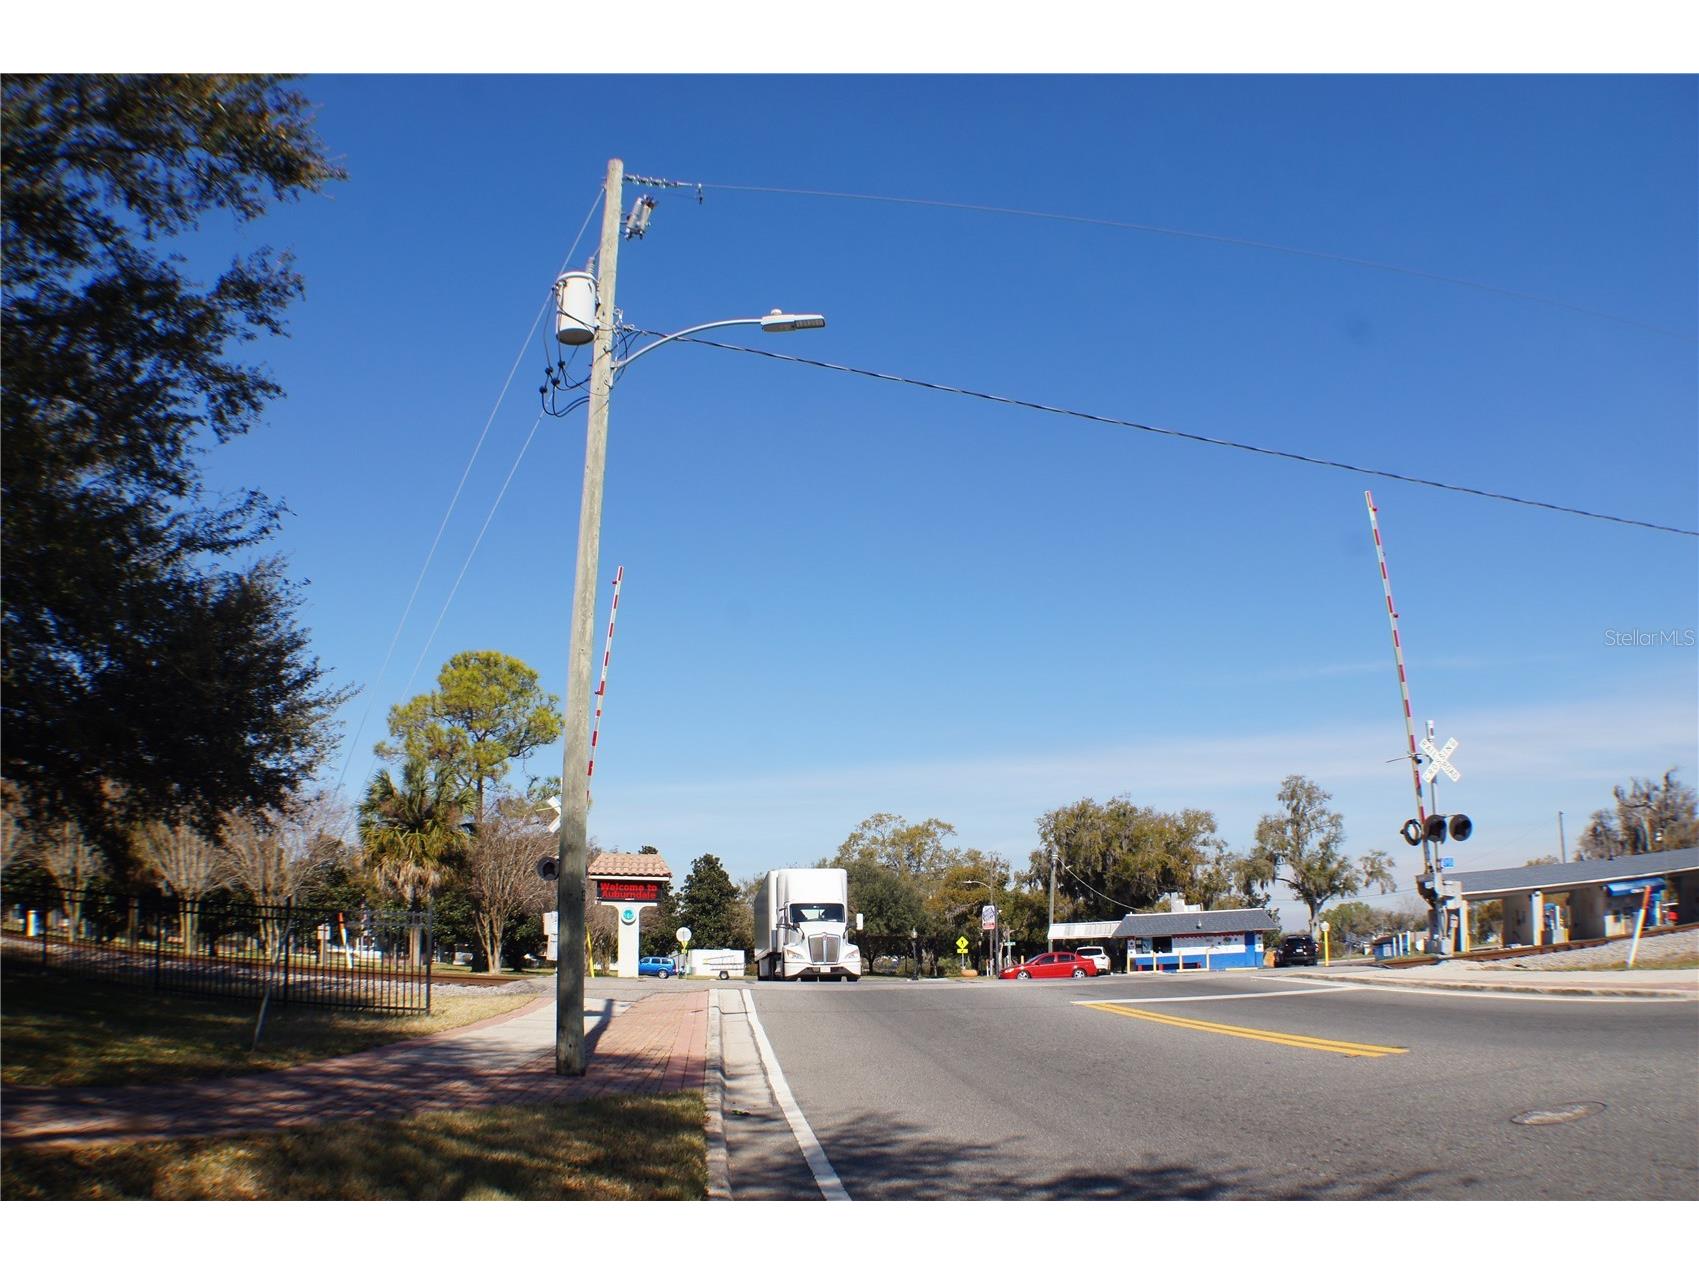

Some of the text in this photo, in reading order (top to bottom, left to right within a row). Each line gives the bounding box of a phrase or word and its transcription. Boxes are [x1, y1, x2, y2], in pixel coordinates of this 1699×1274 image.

[601, 882, 657, 891] Welcome to
[602, 890, 657, 899] Auburndale
